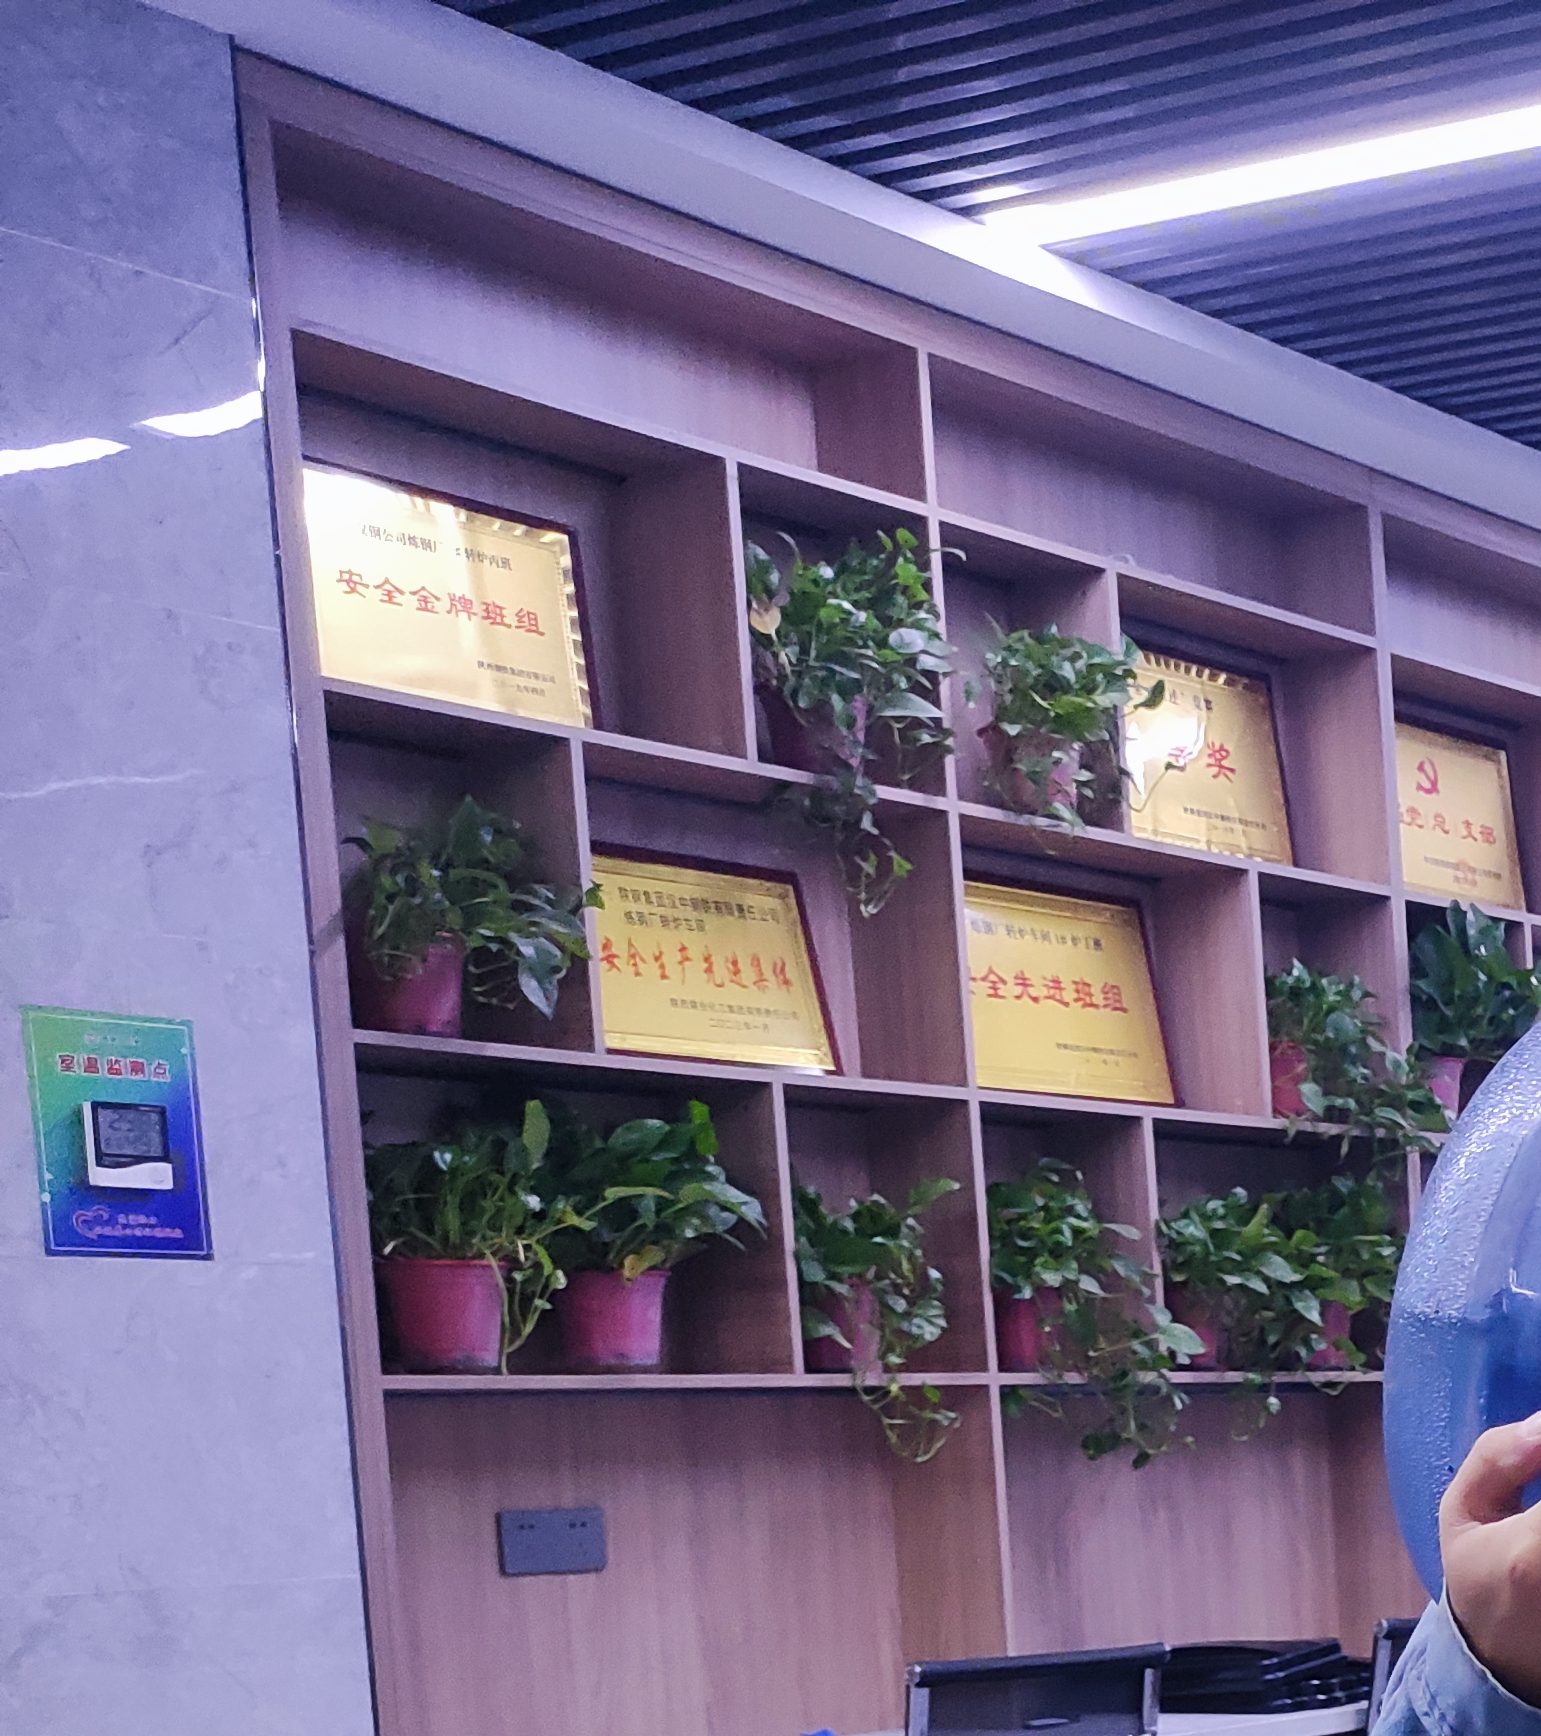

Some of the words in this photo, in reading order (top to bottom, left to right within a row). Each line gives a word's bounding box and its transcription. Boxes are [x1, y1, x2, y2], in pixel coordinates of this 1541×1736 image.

[336, 568, 545, 637] 安全金牌班组
[600, 935, 793, 993] 安全生产先进集体
